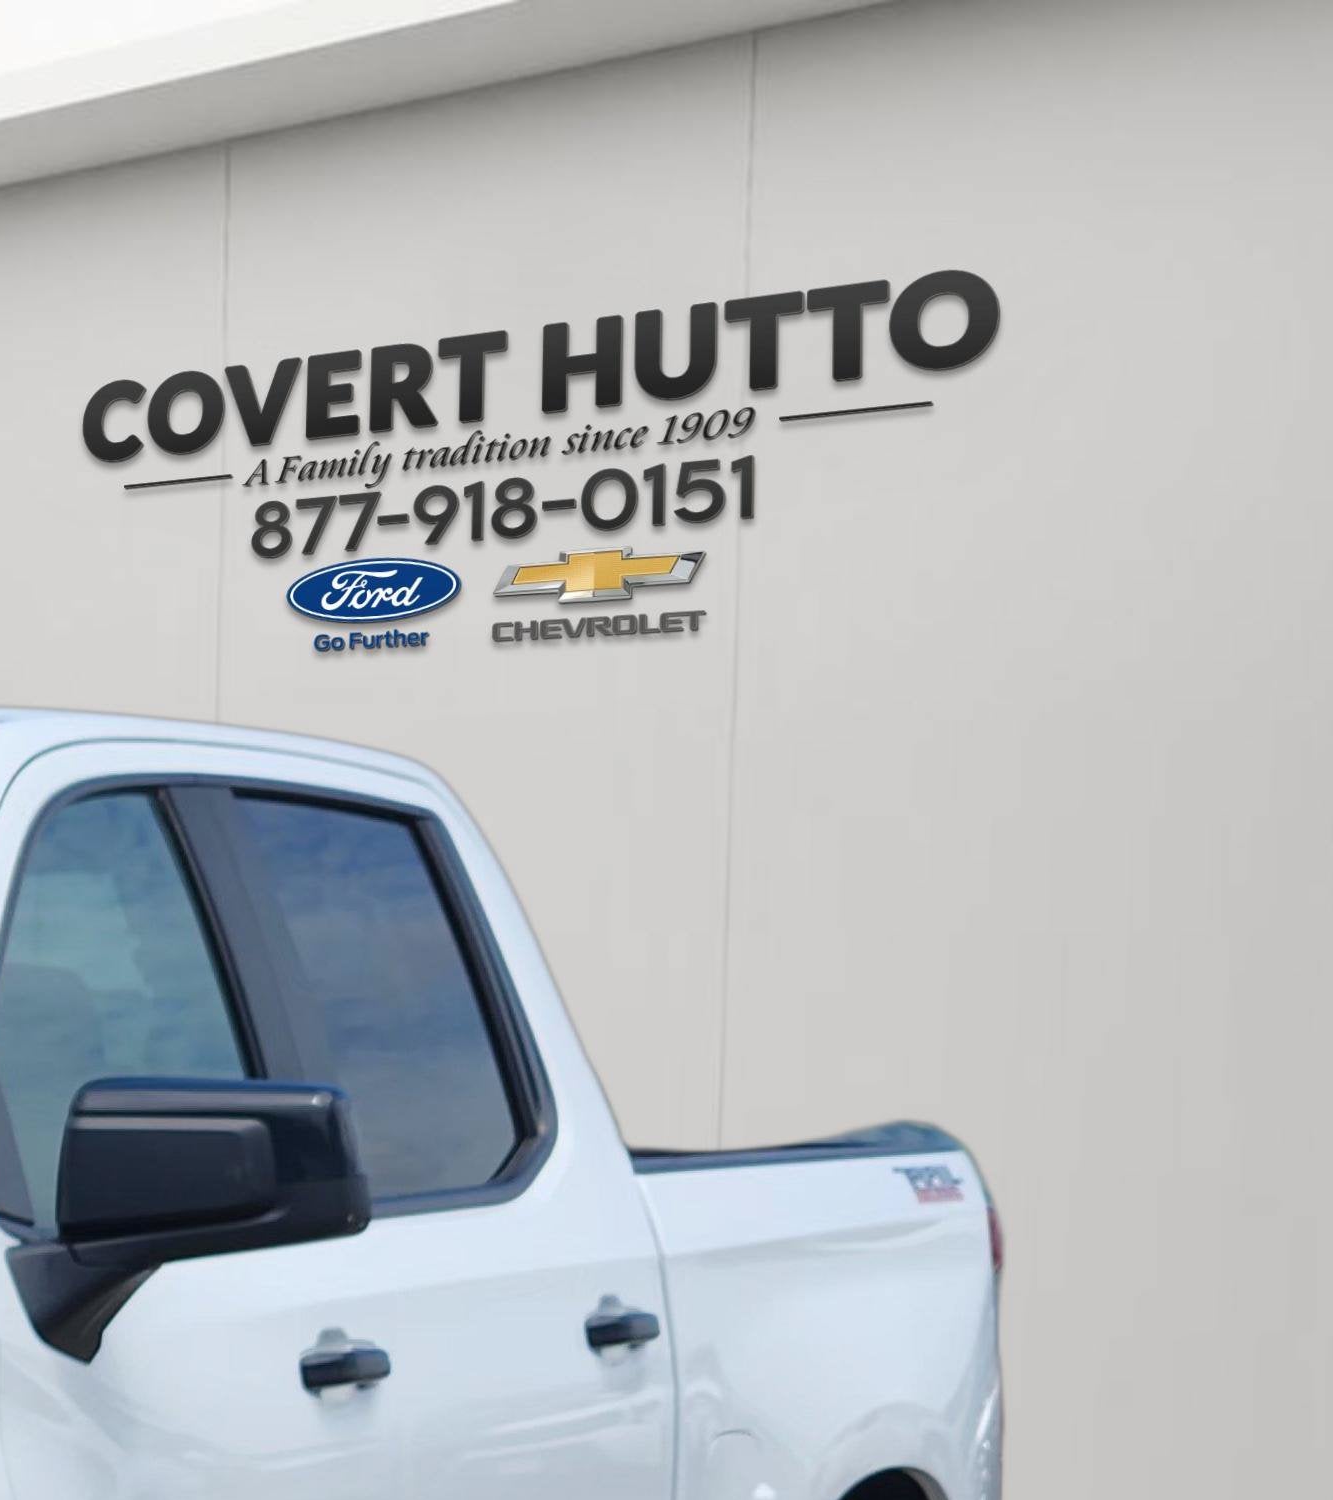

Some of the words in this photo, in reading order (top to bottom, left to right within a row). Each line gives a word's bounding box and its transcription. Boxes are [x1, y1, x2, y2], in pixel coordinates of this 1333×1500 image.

[82, 330, 509, 464] COVERT
[541, 269, 1001, 416] HUTTO
[242, 458, 270, 488] A
[274, 440, 393, 490] Family
[401, 429, 553, 473] tradition
[560, 423, 651, 457] since
[656, 406, 757, 448] 1909
[251, 454, 756, 561] 877-918-0151
[321, 569, 421, 612] Ford
[313, 633, 346, 653] Go
[348, 628, 430, 651] Further
[491, 609, 707, 644] CHEVROLET
